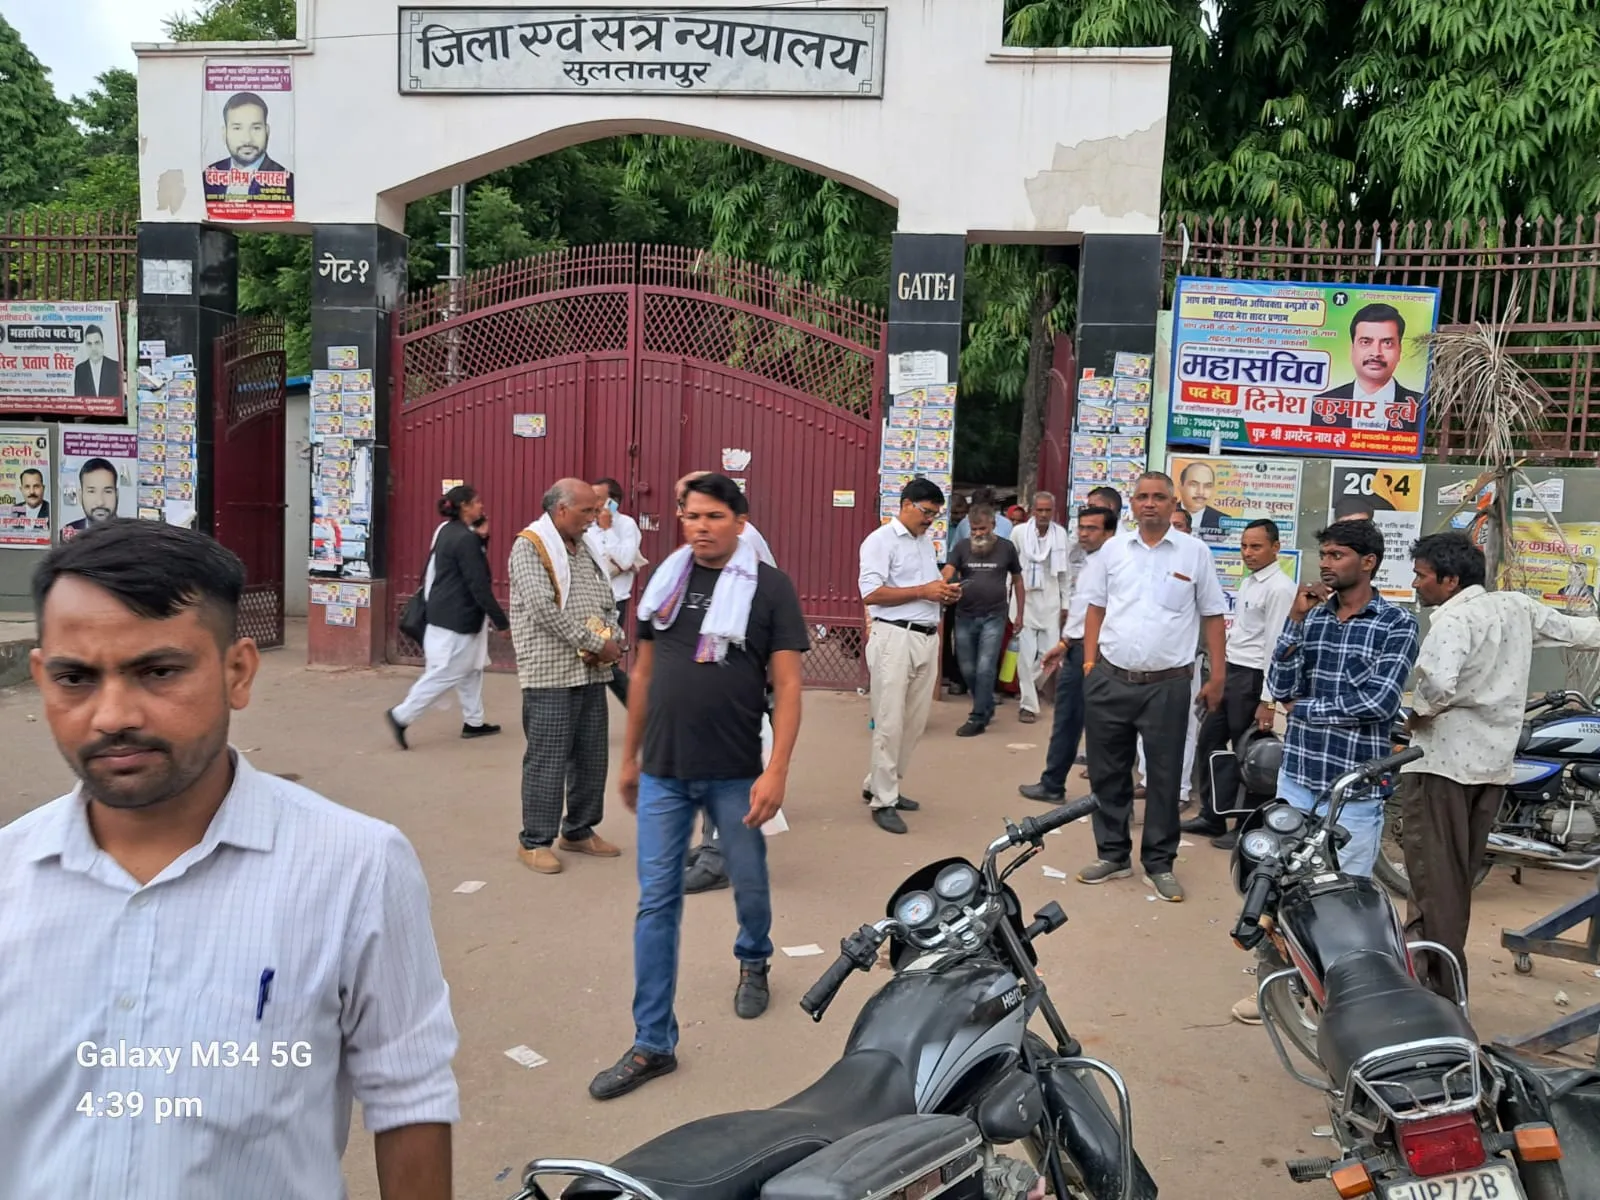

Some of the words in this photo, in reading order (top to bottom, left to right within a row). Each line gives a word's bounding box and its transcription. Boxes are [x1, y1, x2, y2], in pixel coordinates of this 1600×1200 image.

[417, 24, 514, 71] जिला
[518, 14, 586, 57] एवं
[590, 16, 669, 52] सत्र
[674, 17, 868, 76] न्यायालय
[563, 61, 712, 87] सुलतानपुर
[898, 273, 956, 301] GATE-1
[1186, 296, 1199, 305] आप
[1202, 296, 1216, 305] सभी
[1309, 301, 1319, 311] को
[22, 355, 49, 370] प्रताप
[54, 352, 75, 370] सिंह
[1183, 350, 1327, 385] महासचिव
[1188, 386, 1208, 400] पद
[1211, 385, 1232, 403] हेतु
[1244, 387, 1307, 415] दिनेश
[1312, 398, 1377, 424] कुमार
[1384, 396, 1419, 429] दूबे
[1271, 426, 1281, 440] श्री
[1283, 428, 1313, 443] अमरेन्द्र
[1314, 431, 1332, 443] नाथ
[1333, 430, 1346, 447] दूबे
[2, 445, 32, 456] होली
[1214, 496, 1262, 510] अखिलेश
[1265, 500, 1294, 513] शुक्ल
